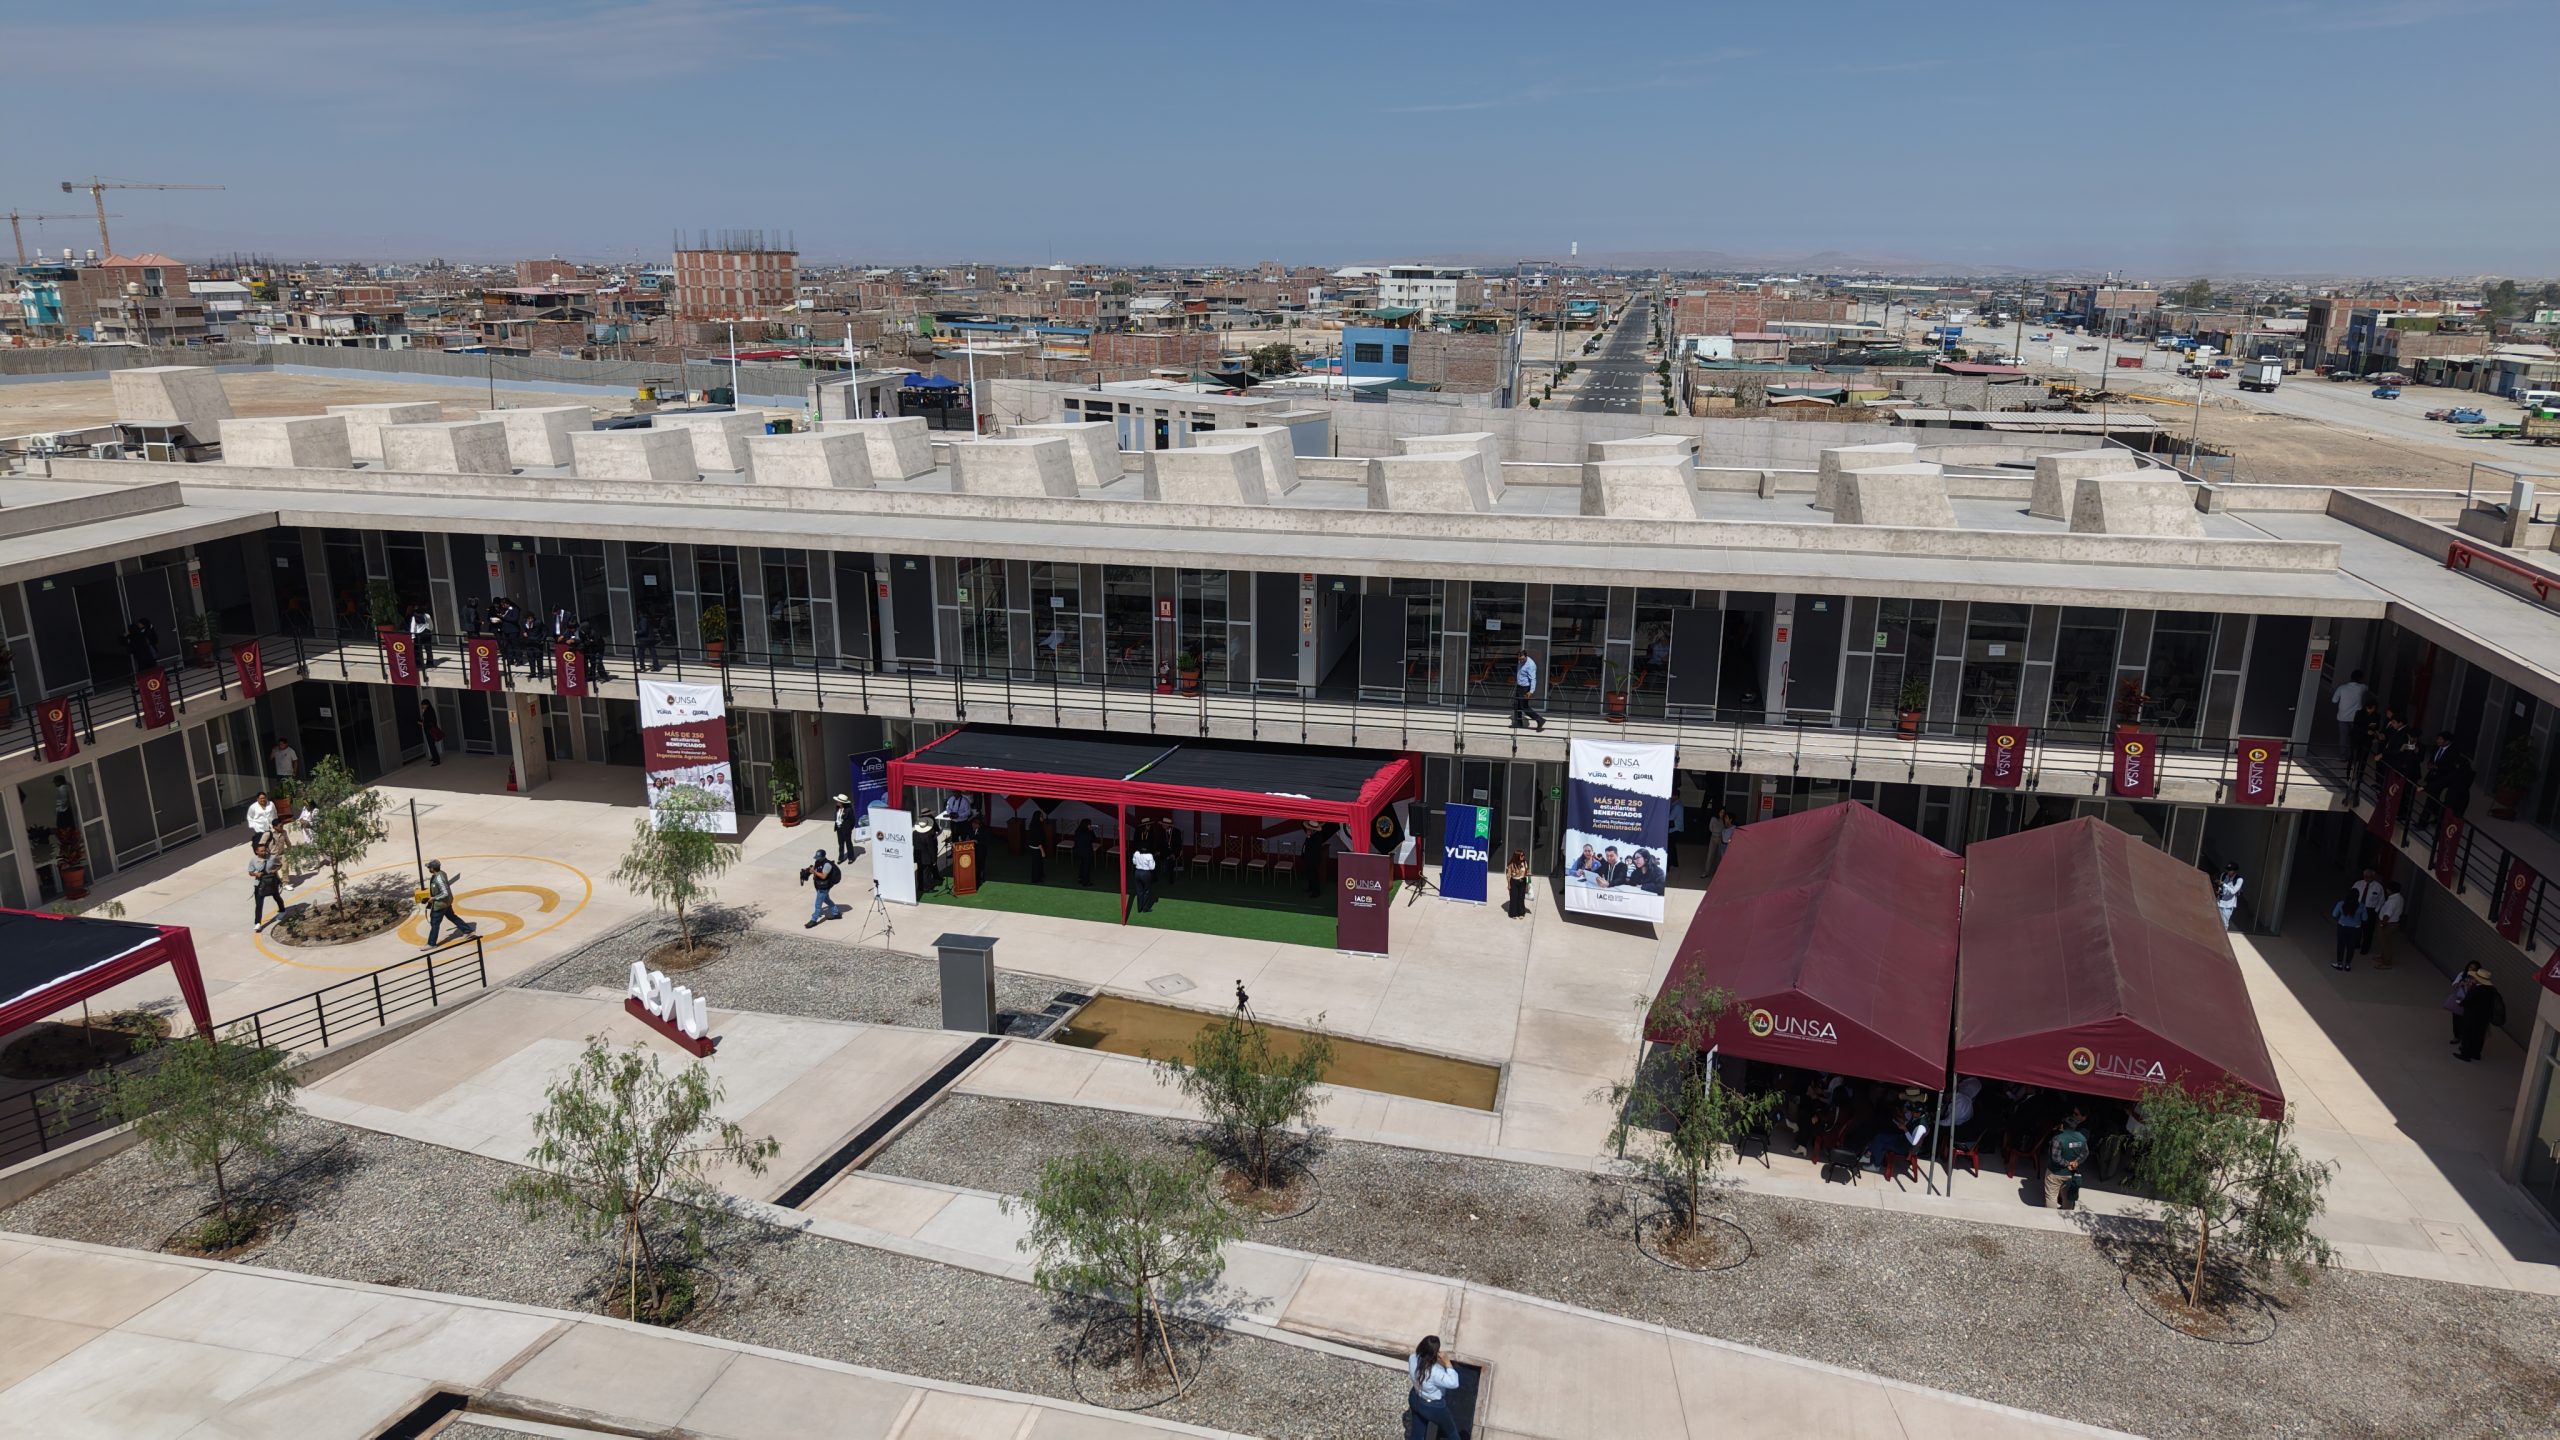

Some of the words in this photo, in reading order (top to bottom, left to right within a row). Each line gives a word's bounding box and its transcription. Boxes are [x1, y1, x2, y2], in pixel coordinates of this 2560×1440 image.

[397, 652, 409, 678] UNSA
[480, 657, 490, 683] UNSA
[567, 661, 577, 688] UNSA
[675, 696, 697, 704] UNSA
[861, 763, 885, 772] URBI
[1613, 757, 1640, 767] UNSA
[1998, 747, 2011, 777] UNSA
[1633, 773, 1653, 781] GLORIA
[2127, 755, 2141, 787] UNSA
[2250, 761, 2264, 794] UNSA
[1593, 796, 1612, 804] MÁS
[1614, 798, 1626, 806] DE
[1628, 799, 1643, 807] 250
[1593, 809, 1643, 818] BENEFICIADOS
[1592, 823, 1642, 832] Administración
[884, 832, 906, 842] UNSA
[1445, 846, 1488, 862] YURA
[1355, 880, 1382, 889] UNSA
[1774, 1014, 1838, 1040] UNSA
[2095, 1053, 2167, 1080] UNSA
